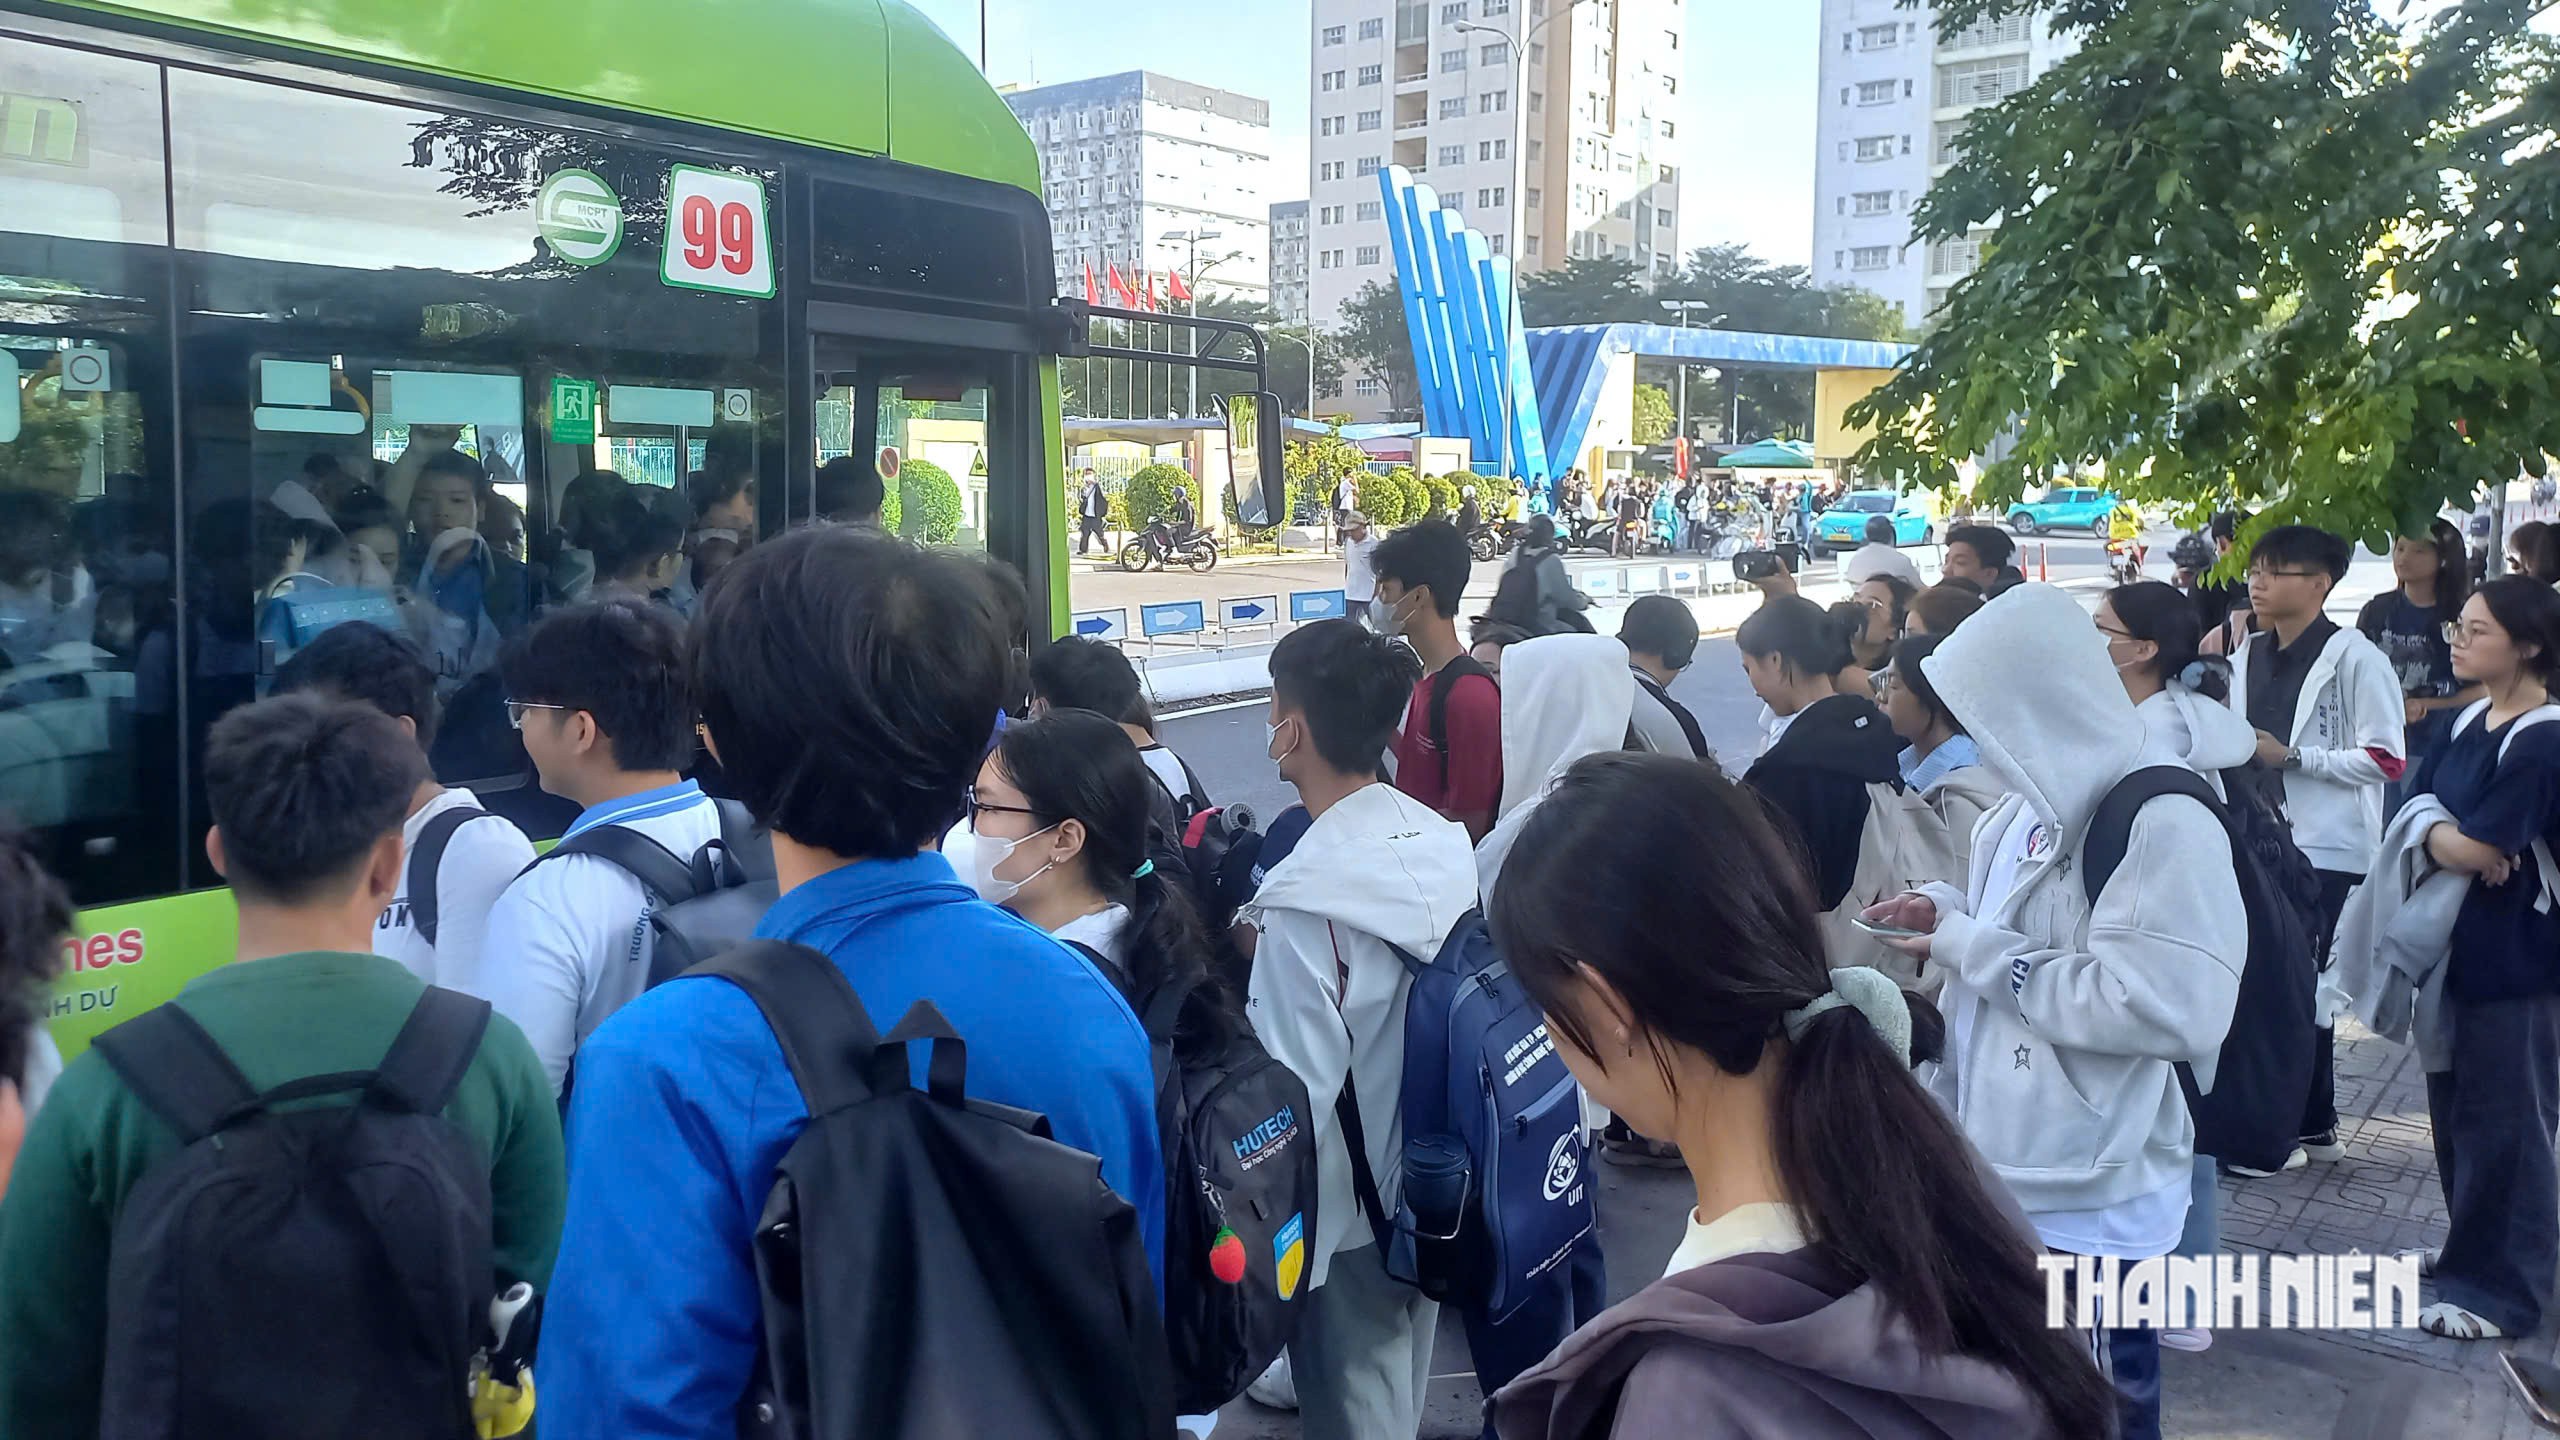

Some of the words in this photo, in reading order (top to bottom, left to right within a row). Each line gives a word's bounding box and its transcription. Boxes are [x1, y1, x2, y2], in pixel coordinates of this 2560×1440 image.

[577, 204, 608, 219] MCPT
[682, 195, 753, 276] 99
[80, 984, 119, 1013] DỰ
[1232, 1104, 1294, 1160] HUTECH
[1568, 1183, 1584, 1207] UIT
